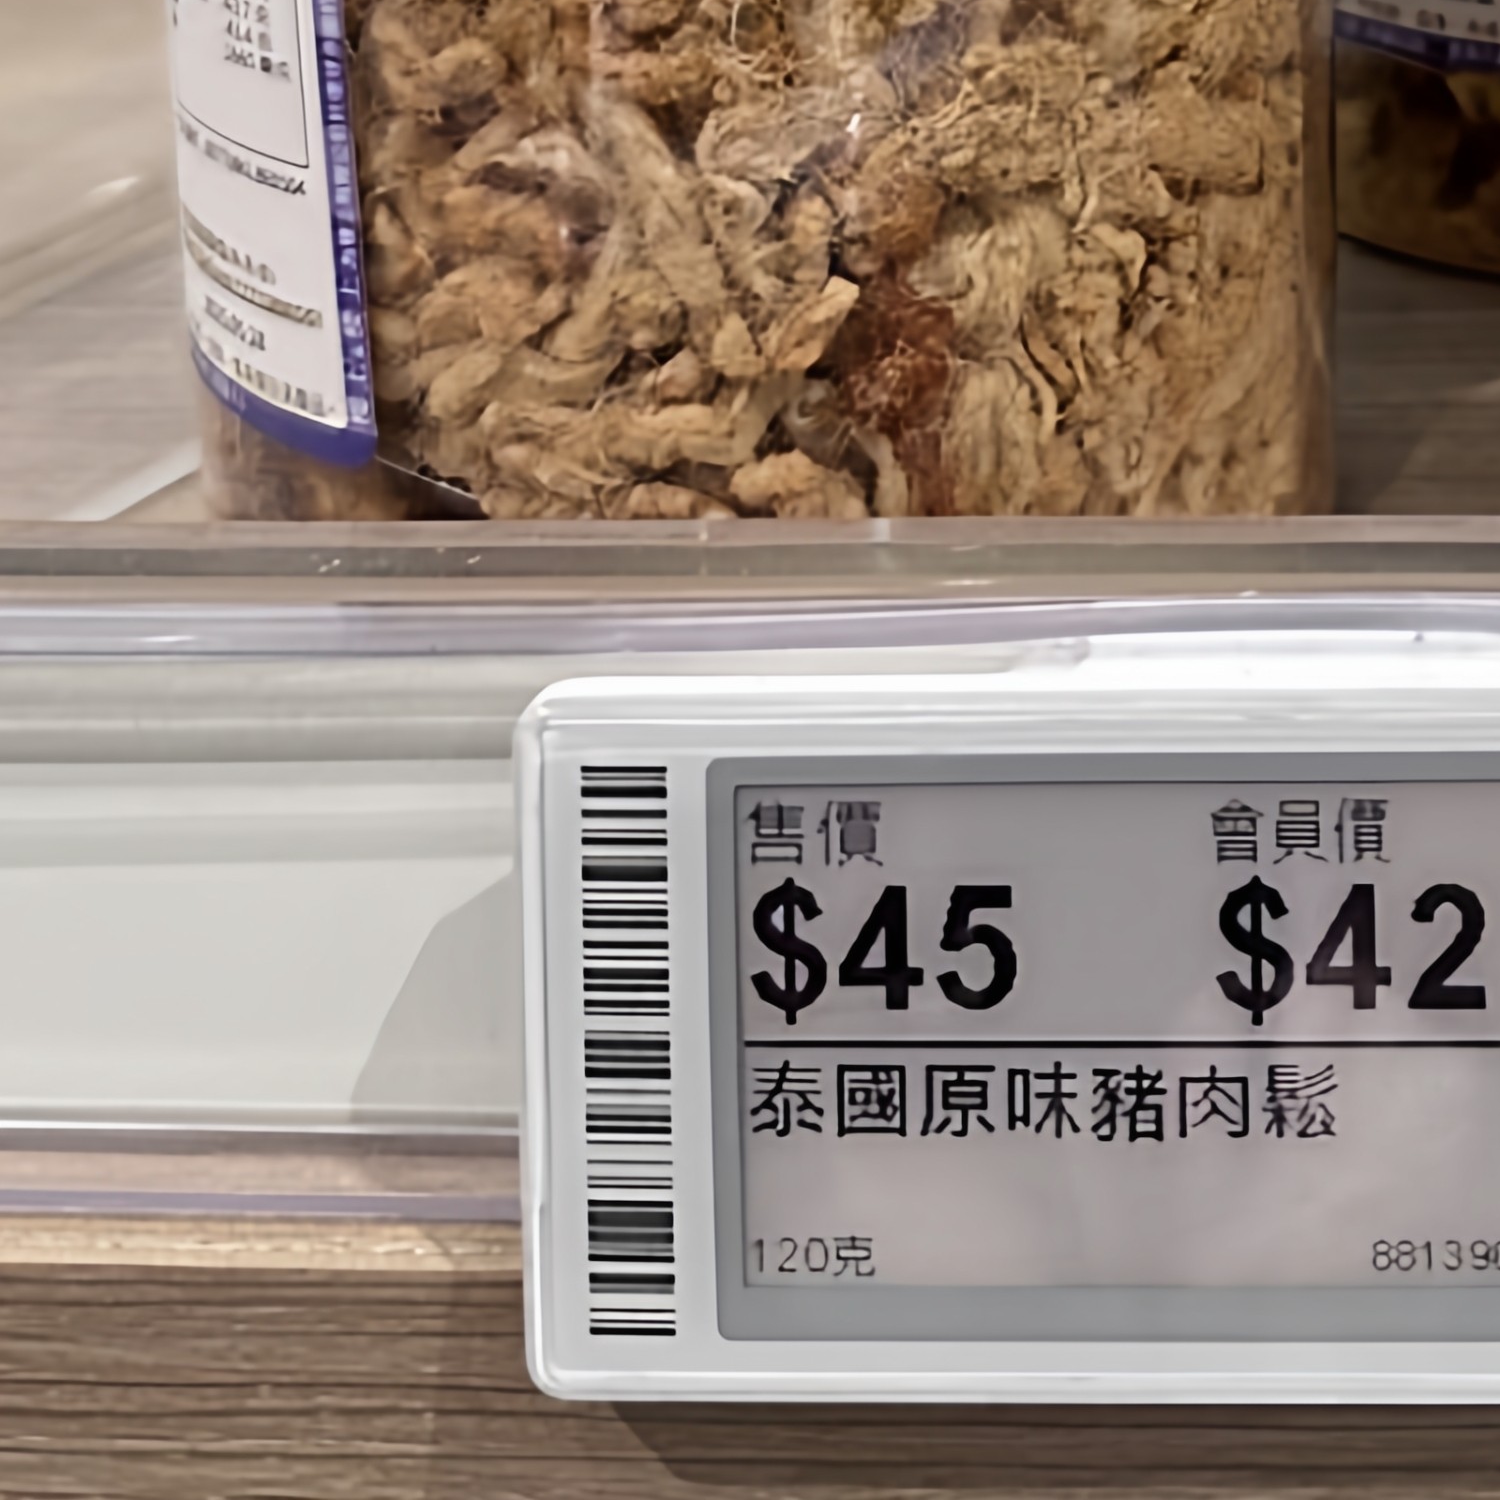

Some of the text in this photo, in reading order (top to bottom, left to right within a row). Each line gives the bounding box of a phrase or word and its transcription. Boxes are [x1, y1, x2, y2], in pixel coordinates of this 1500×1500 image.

[747, 798, 1391, 867] 售價 會員價
[750, 874, 1488, 1026] $45 $42
[750, 1058, 1339, 1143] 泰國原味豬肉鬆
[751, 1235, 876, 1277] 120克
